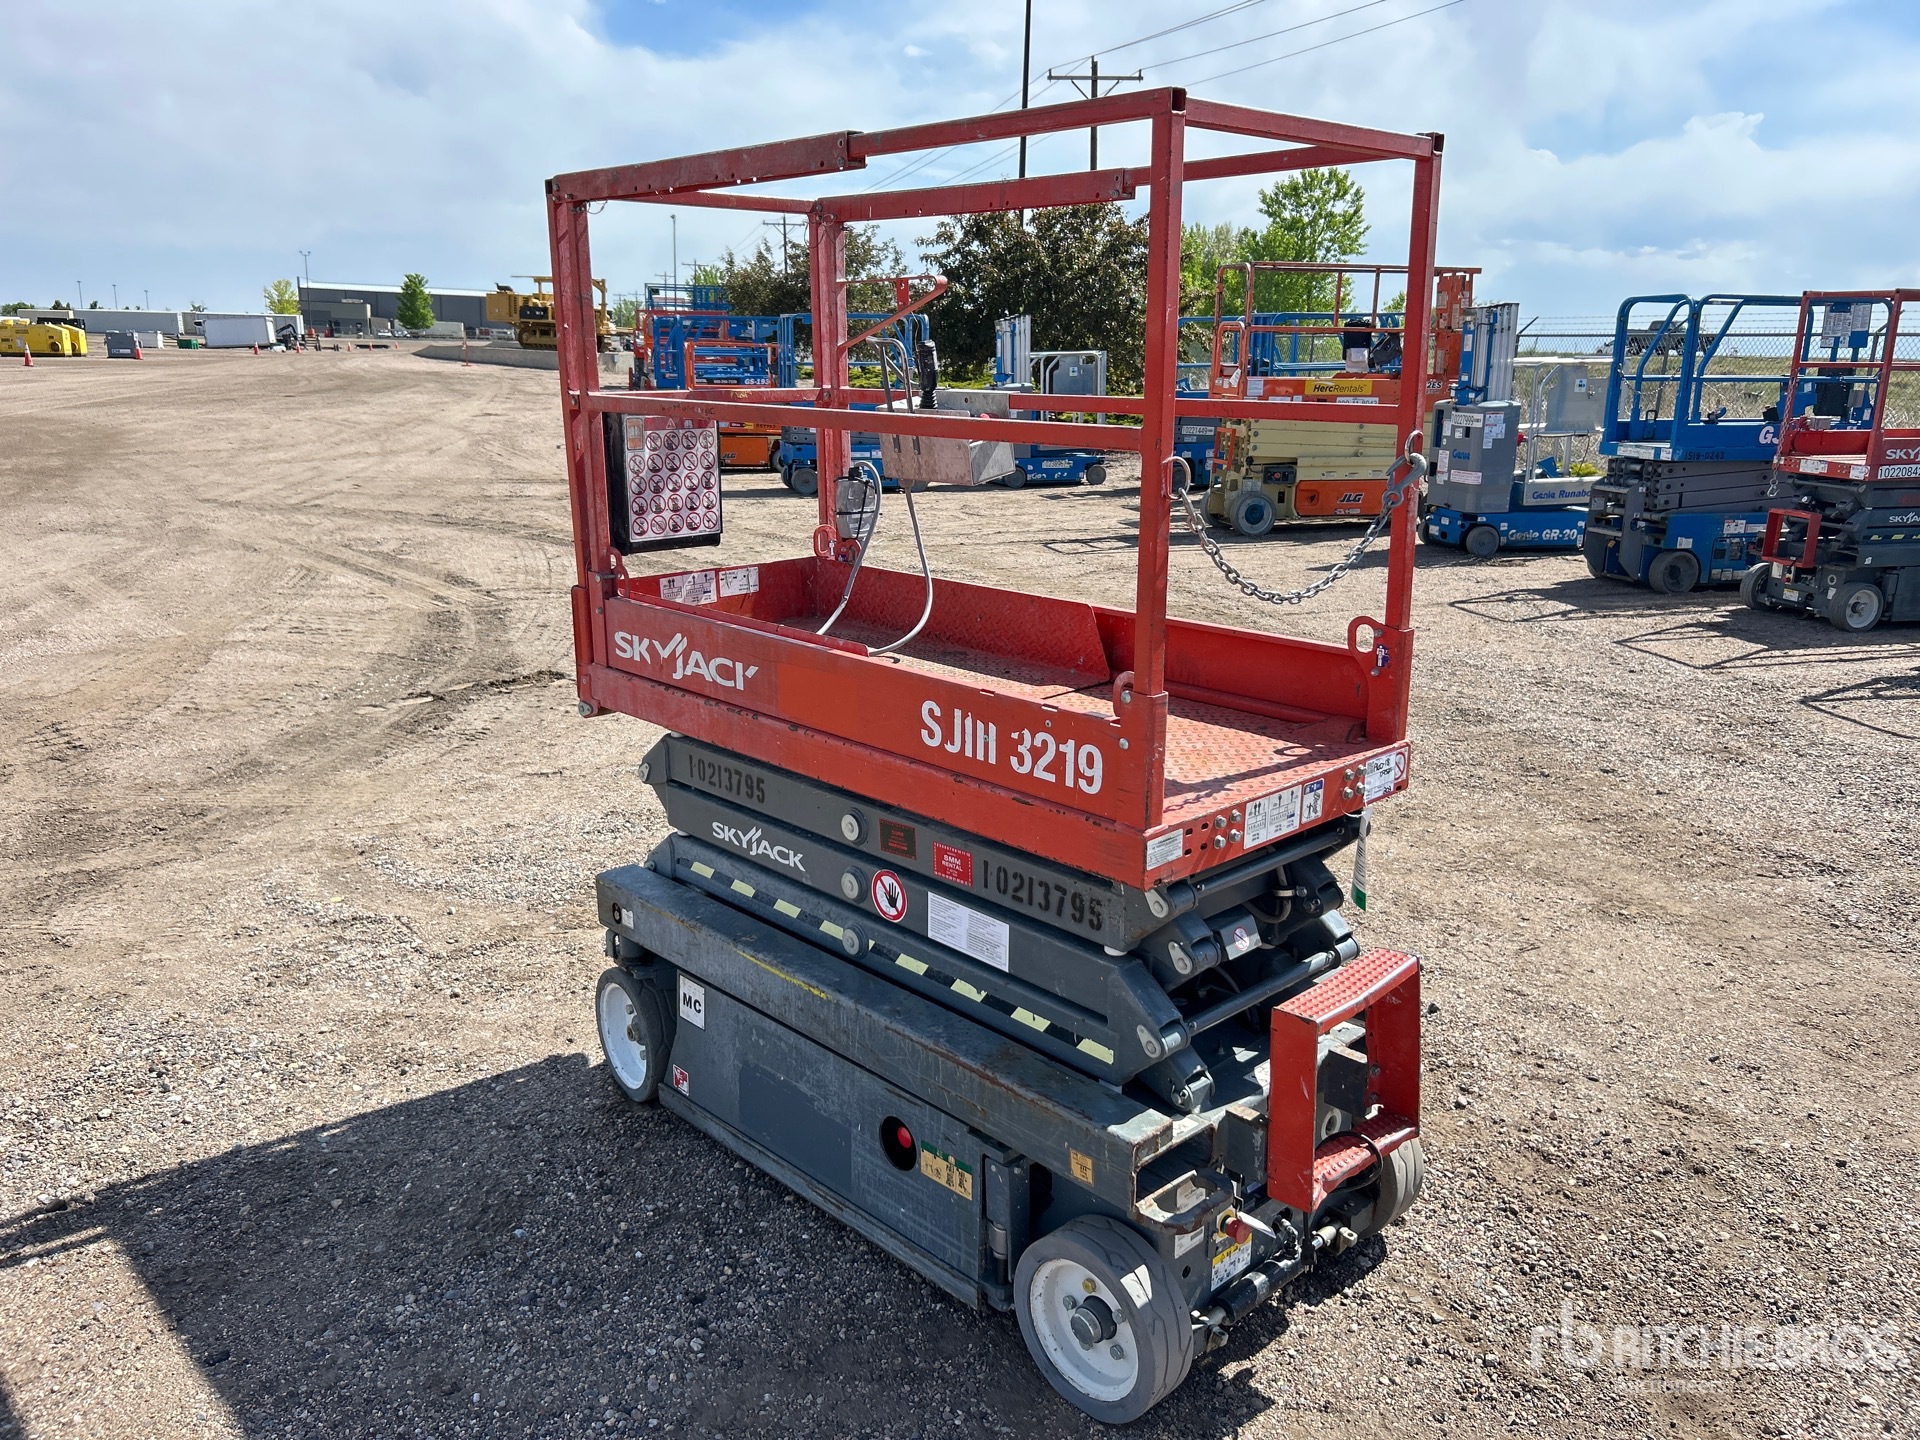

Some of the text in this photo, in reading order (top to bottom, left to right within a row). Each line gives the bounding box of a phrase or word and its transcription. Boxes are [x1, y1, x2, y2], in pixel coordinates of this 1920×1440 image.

[1313, 384, 1364, 393] HercRentals
[1338, 493, 1364, 503] JLG
[1532, 491, 1556, 500] Genie
[1541, 528, 1578, 541] GR-20
[614, 630, 759, 691] SKYJACK
[688, 754, 766, 804] 10213795
[1009, 728, 1103, 795] 3219
[711, 821, 806, 872] SKYJACK
[983, 859, 1103, 931] 10213795
[682, 991, 702, 1014] MC
